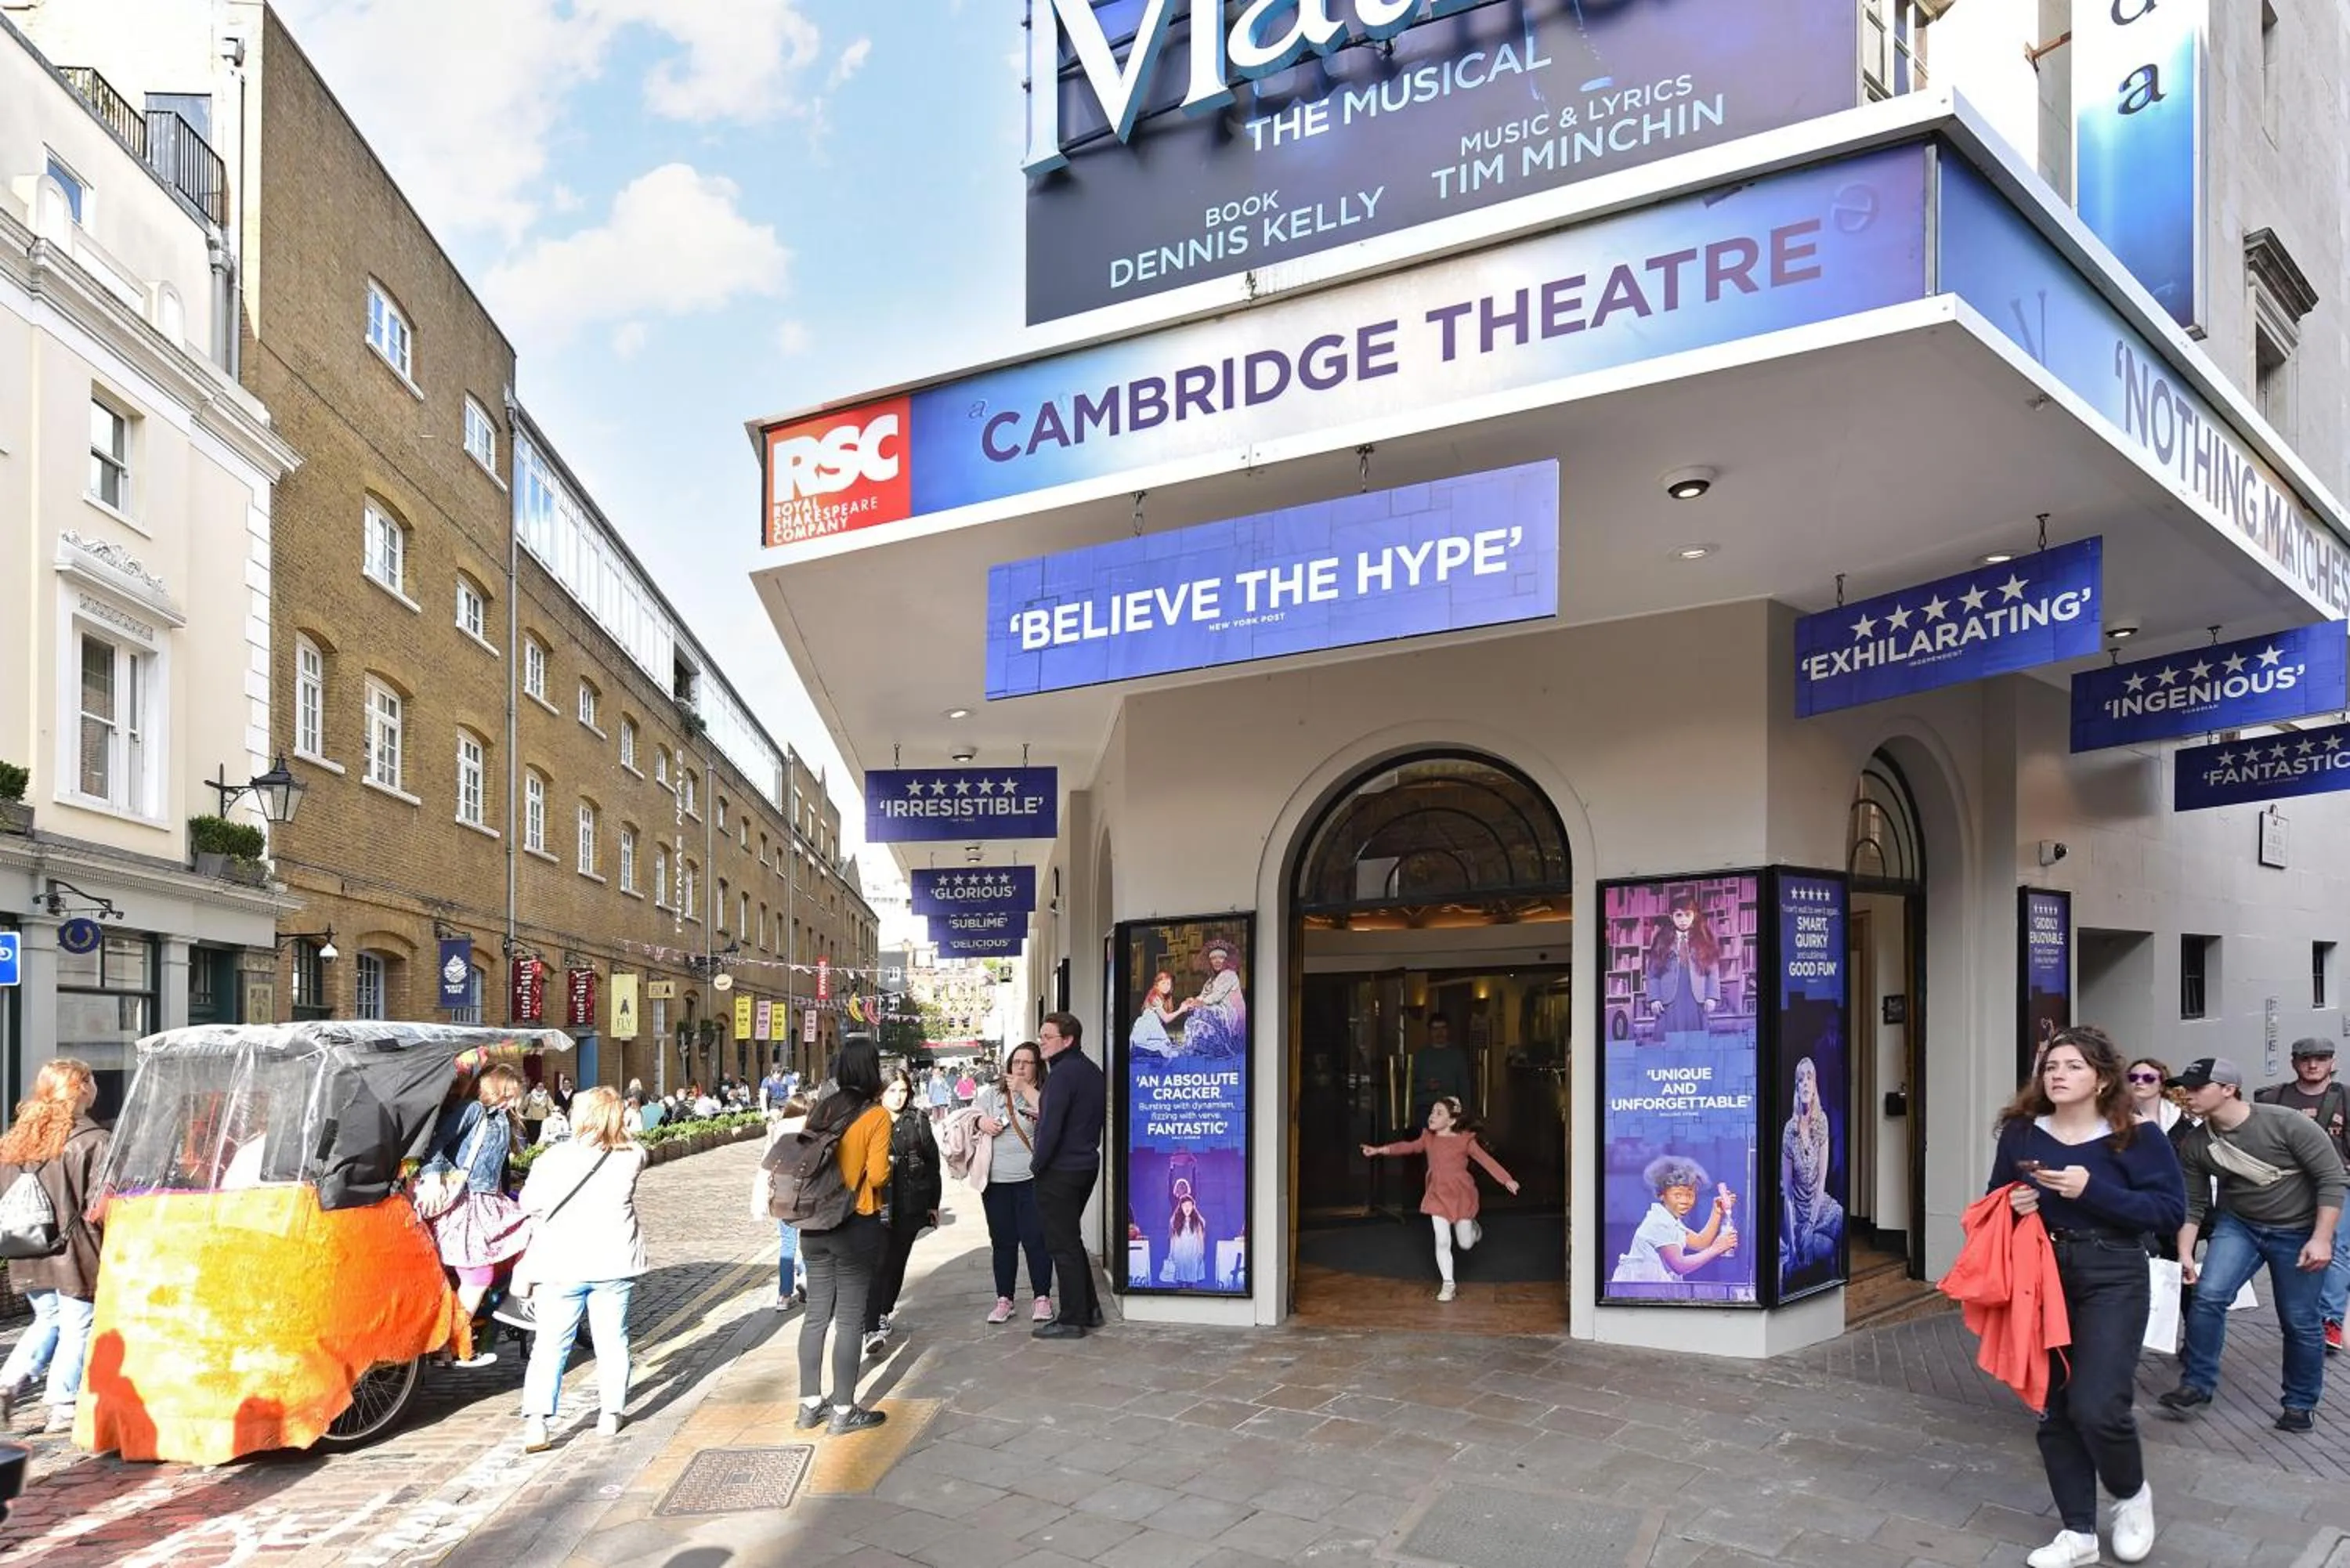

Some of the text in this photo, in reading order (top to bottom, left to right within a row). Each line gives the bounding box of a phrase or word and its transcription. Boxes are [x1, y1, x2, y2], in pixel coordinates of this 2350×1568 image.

[1246, 35, 1552, 152] THE MUSICAL
[1461, 75, 1693, 156] MUSIC & LYRICS
[1432, 93, 1724, 200] TIM MINCHIN
[1206, 190, 1280, 229] BOOK
[1110, 186, 1385, 288] DENNIS KELLY
[981, 218, 1822, 462] CAMBRIDGE THEATRE
[773, 414, 898, 504] RSC
[774, 497, 818, 518] ROYAL
[774, 496, 878, 532] SHAKESPEARE
[773, 516, 848, 544] COMPANY
[2265, 482, 2348, 617] MATCHES
[1010, 526, 1522, 650] 'BELIEVE THE HYPE'
[1209, 612, 1285, 631] NEW YORK POST
[1802, 587, 2092, 681] 'EXHILARATING'
[2105, 663, 2305, 720] 'INGENIOUS'
[880, 796, 1043, 818] 'IRRESISTIBLE'
[930, 886, 1016, 900] 'GLORIOUS'
[1795, 933, 1829, 948] QUIRKY
[1788, 961, 1816, 977] GOOD
[1163, 1072, 1239, 1086] ABSOLUTE
[1647, 1068, 1713, 1082] 'UNIQUE
[1661, 1082, 1697, 1096] AND
[1611, 1095, 1752, 1111] UNFORGETTABLE'
[1148, 1122, 1228, 1136] FANTASTIC'
